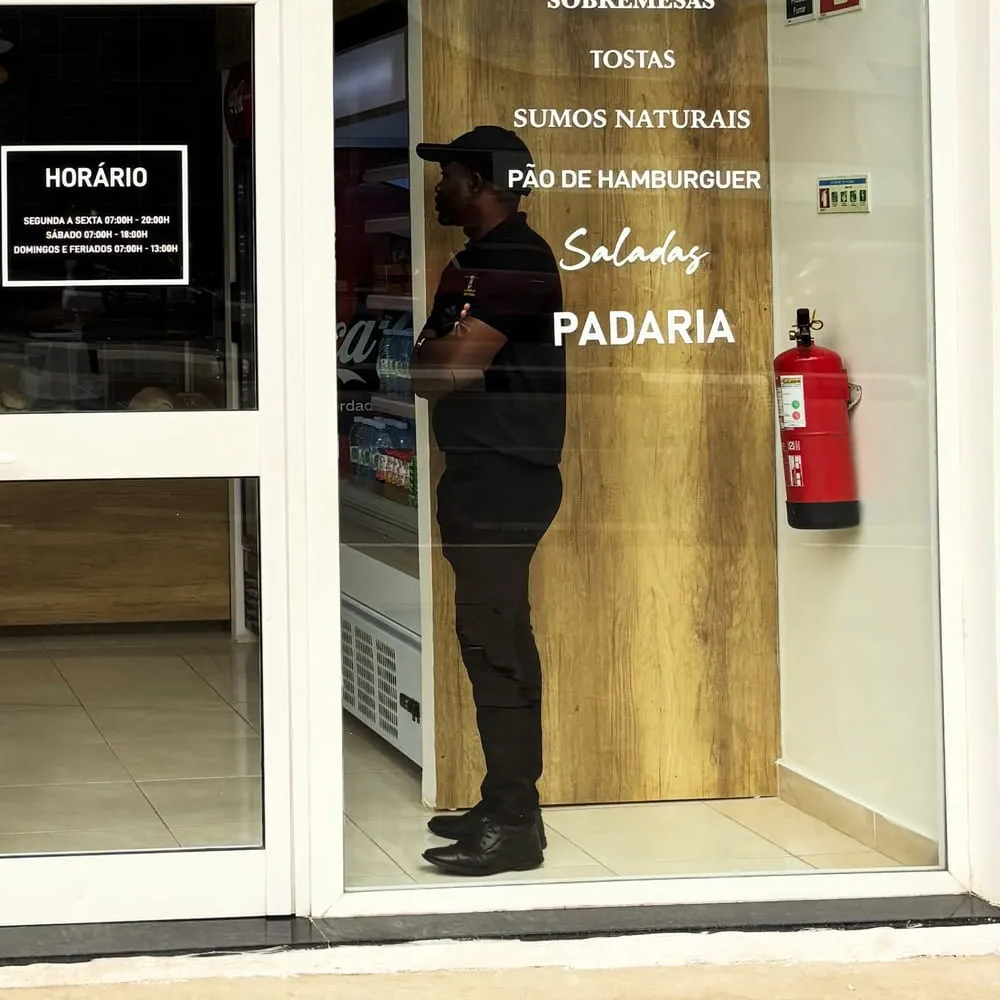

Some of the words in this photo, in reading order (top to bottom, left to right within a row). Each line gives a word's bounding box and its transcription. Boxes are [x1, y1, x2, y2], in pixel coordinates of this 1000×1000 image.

[590, 49, 676, 70] TOSTAS
[513, 108, 607, 129] SUMOS
[614, 109, 751, 129] NATURAIS
[45, 162, 148, 188] HORÁRIO
[508, 163, 555, 188] PÃO
[561, 169, 592, 188] DE
[598, 169, 761, 189] HAMBURGUER
[23, 216, 66, 226] SEGUNDA
[66, 216, 74, 225] A
[74, 216, 103, 225] SEXTA
[104, 216, 133, 225] 07:00H
[140, 215, 170, 225] 20:00H
[45, 229, 82, 240] SÁBADO
[83, 230, 113, 239] 07:00H
[13, 245, 60, 255] DOMINGOS
[61, 245, 68, 254] E
[69, 245, 113, 254] FERIADOS
[114, 244, 143, 254] 07:00H
[150, 244, 179, 253] 13:00H
[559, 226, 710, 275] Saladas
[553, 308, 736, 347] PADARIA
